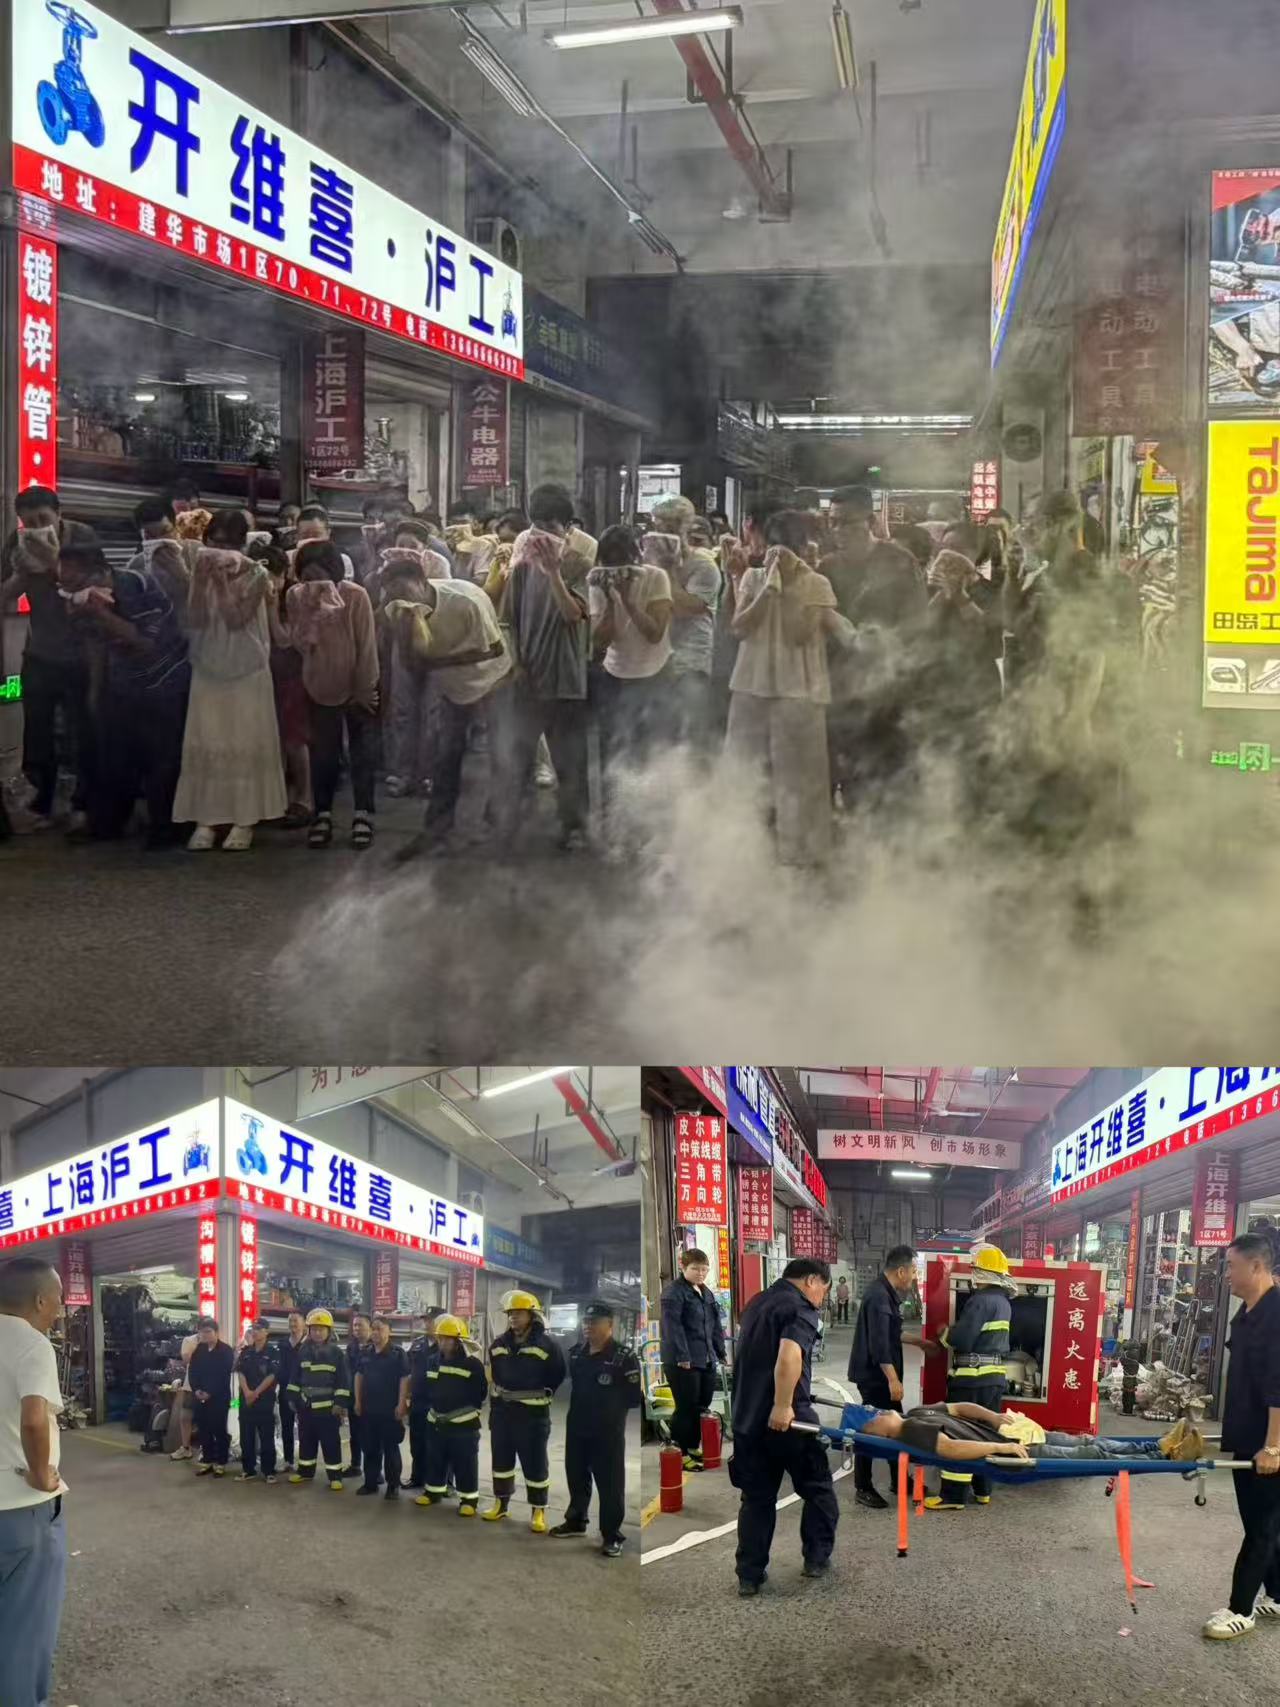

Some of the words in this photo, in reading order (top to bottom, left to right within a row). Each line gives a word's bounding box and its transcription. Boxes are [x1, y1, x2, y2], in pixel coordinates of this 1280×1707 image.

[23, 244, 53, 487] 镀锌管·
[314, 335, 348, 442] 上海沪工
[470, 385, 501, 466] 公牛电器
[833, 1133, 916, 1150] 树文明新风
[930, 1137, 1007, 1158] 创市场形象
[1062, 1281, 1090, 1390] 远离火患
